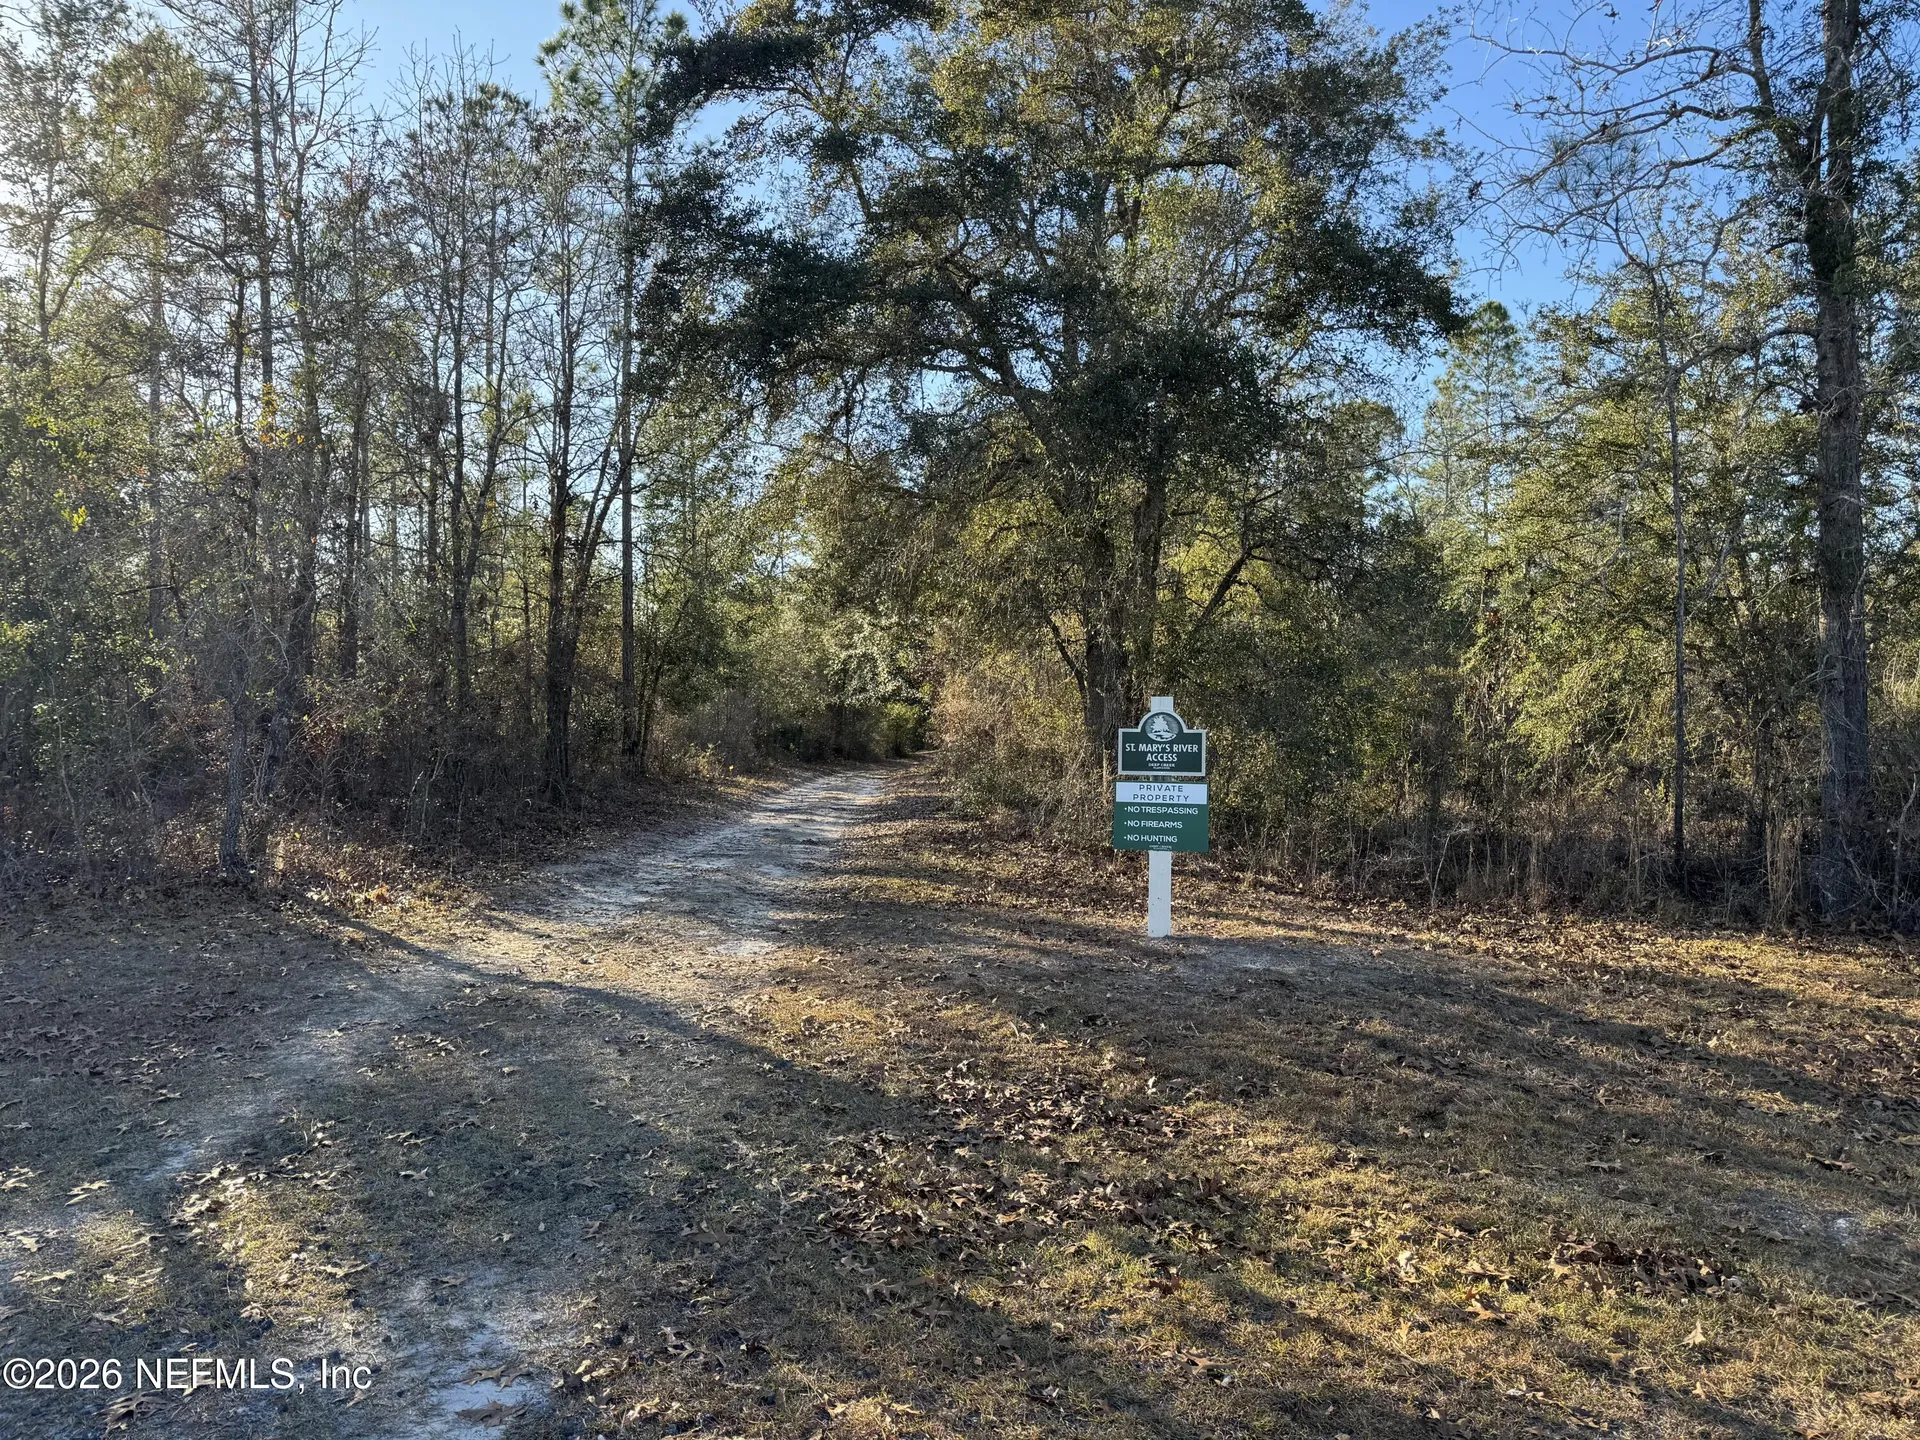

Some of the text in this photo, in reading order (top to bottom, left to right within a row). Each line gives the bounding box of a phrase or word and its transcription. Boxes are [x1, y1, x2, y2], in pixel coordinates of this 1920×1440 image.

[1125, 743, 1198, 753] ST. MARY'S RIVER
[1146, 753, 1177, 762] ACCESS
[1139, 784, 1183, 792] PRIVATE
[1133, 794, 1189, 802] PROPERTY
[1141, 806, 1198, 815] TRESPASSING
[1141, 820, 1183, 828] FIREARMS
[1140, 835, 1178, 843] HUNTING
